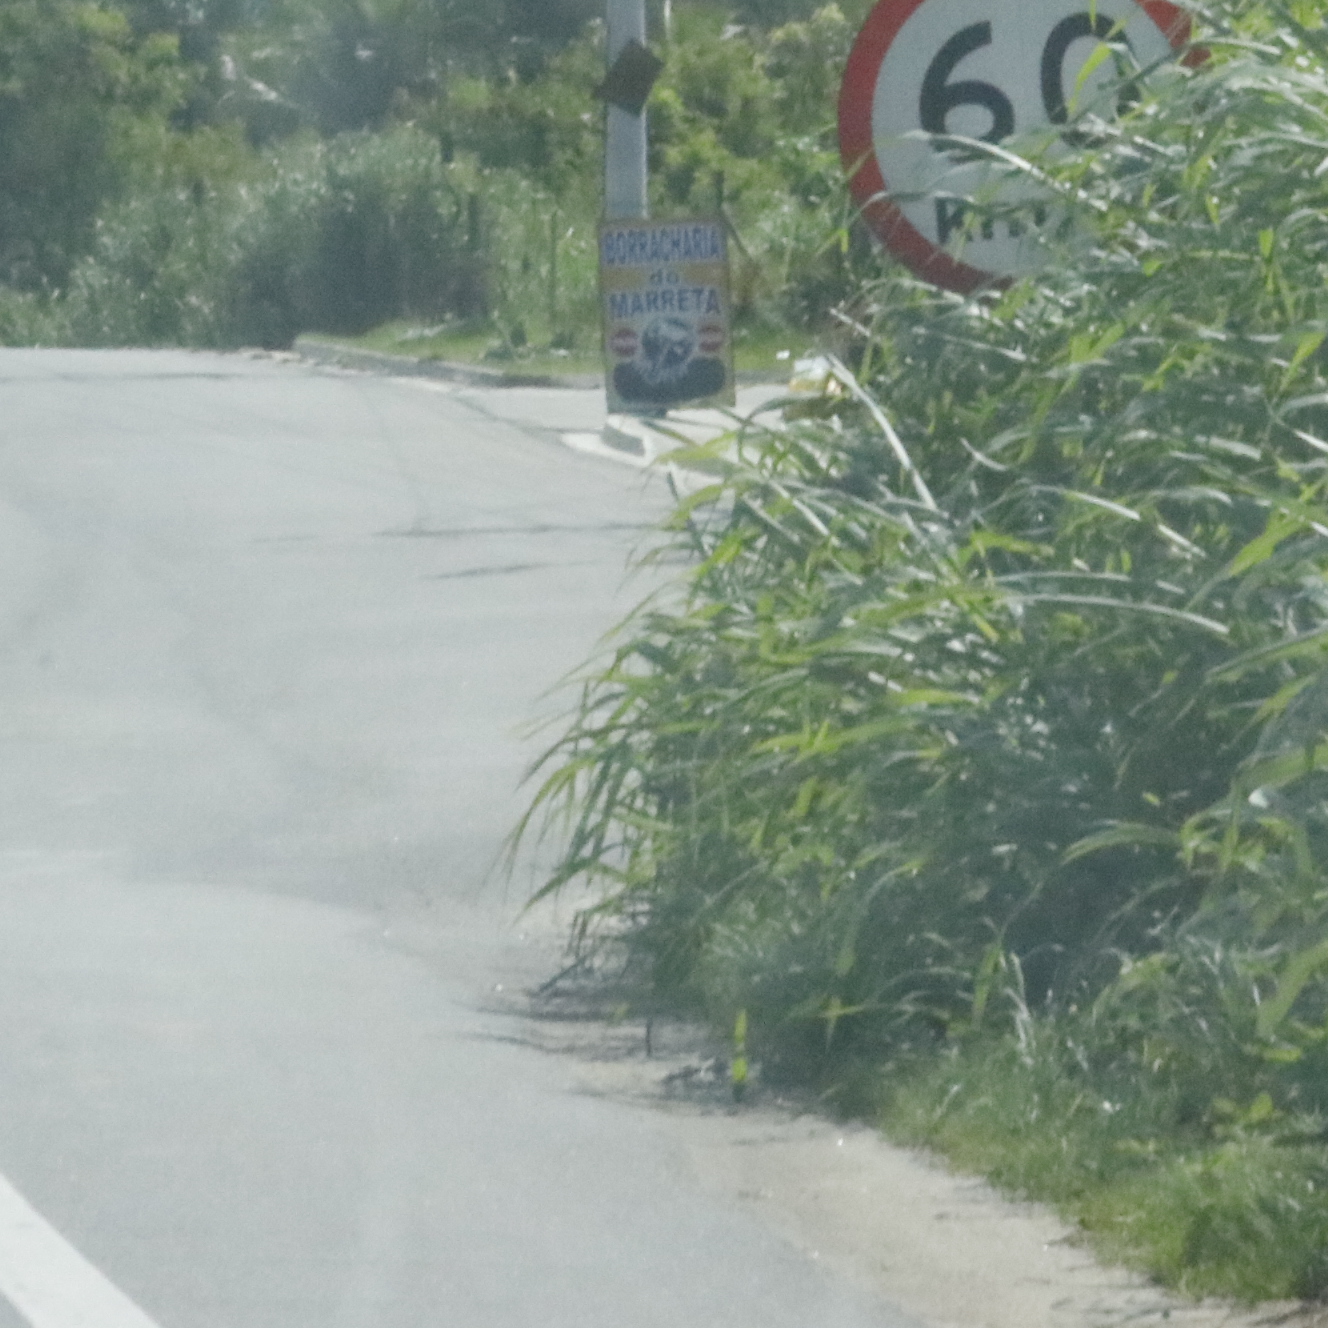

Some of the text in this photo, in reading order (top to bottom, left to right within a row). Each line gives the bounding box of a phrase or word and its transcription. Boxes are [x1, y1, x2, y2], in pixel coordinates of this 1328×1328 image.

[919, 12, 1142, 163] 60
[604, 227, 721, 264] BORRACHARIA
[610, 288, 721, 319] MARRETA
